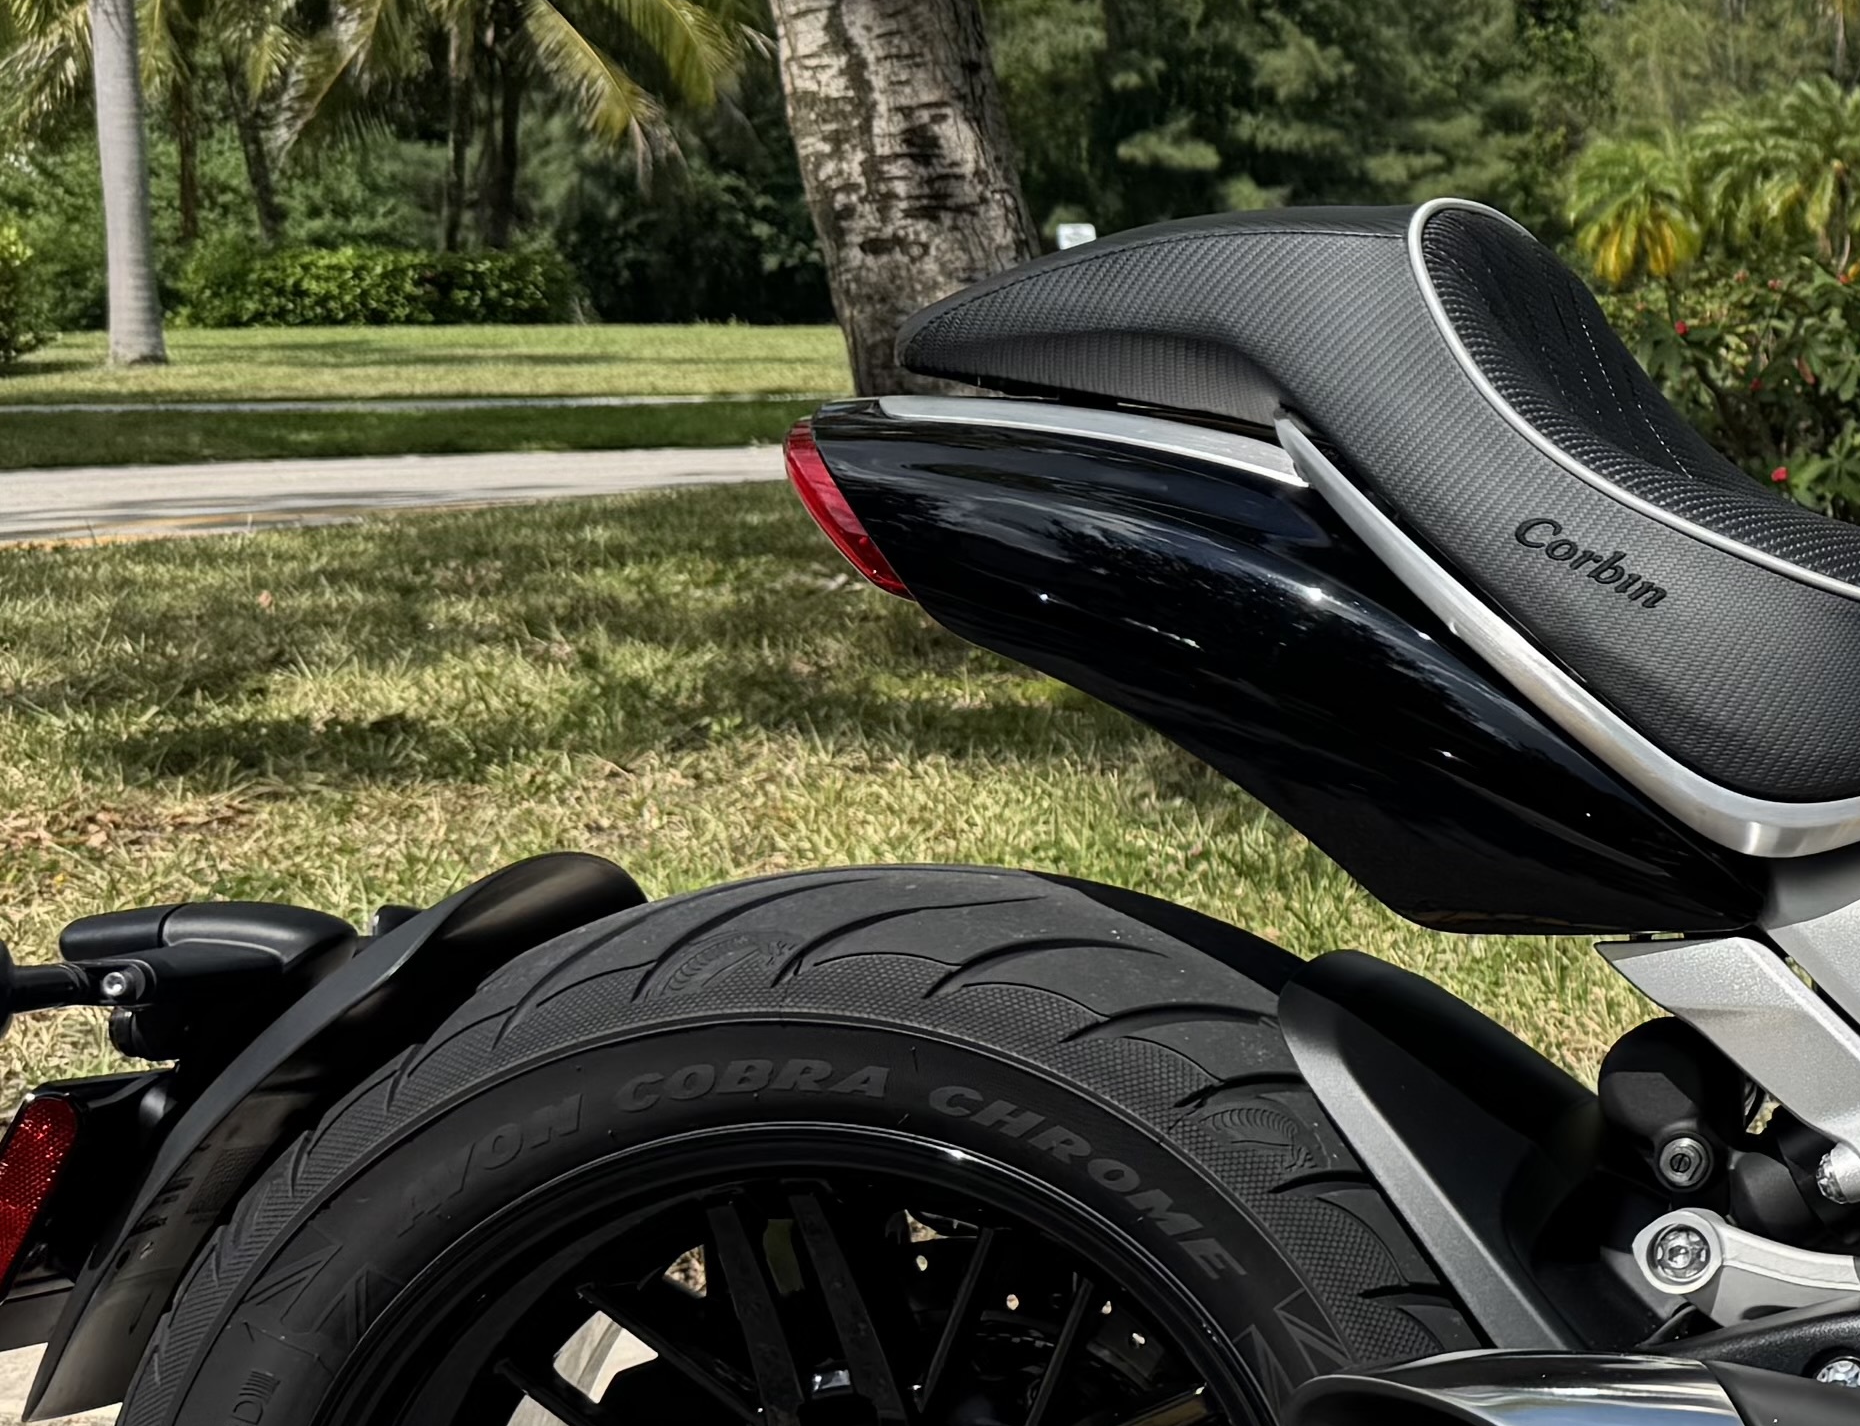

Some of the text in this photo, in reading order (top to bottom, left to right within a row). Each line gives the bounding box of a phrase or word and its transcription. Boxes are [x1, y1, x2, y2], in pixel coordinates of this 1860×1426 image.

[1514, 517, 1668, 609] Corbin
[396, 1057, 1248, 1284] AVON COBRA CHROME
